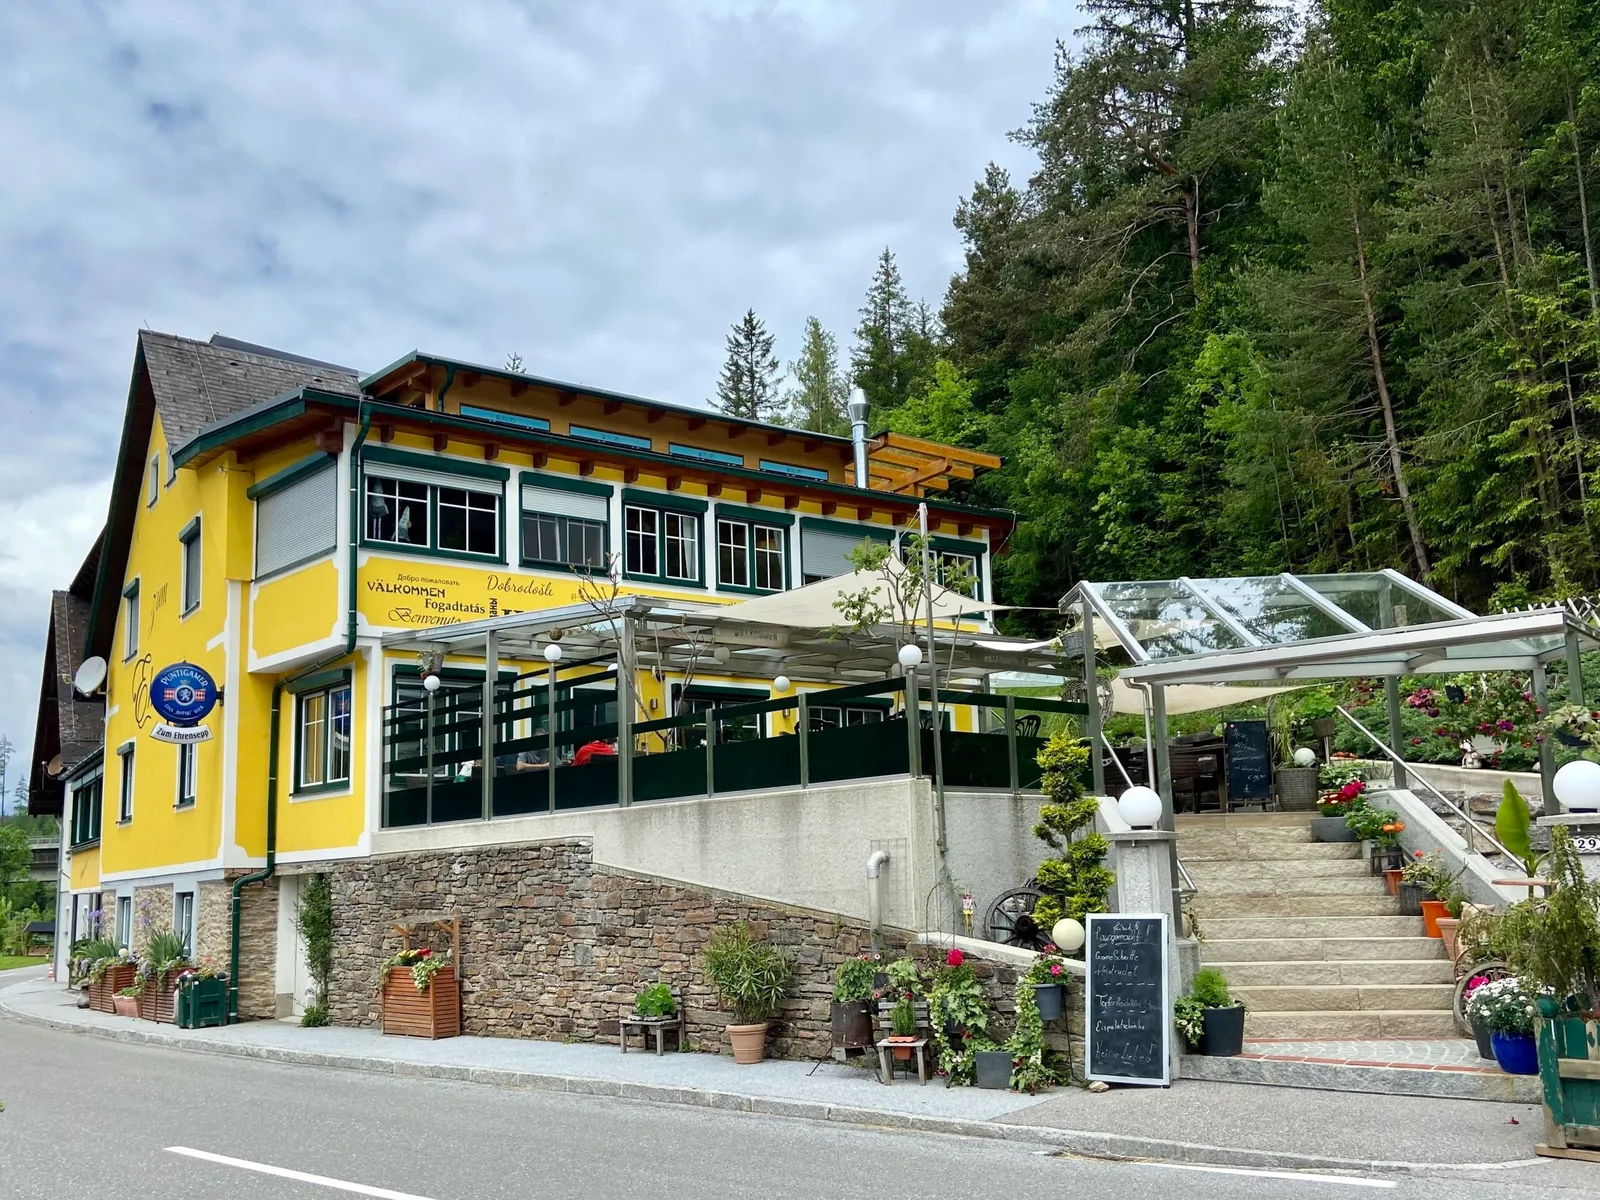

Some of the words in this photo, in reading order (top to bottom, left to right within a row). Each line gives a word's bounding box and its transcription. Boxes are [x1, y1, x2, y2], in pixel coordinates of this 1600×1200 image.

[397, 573, 420, 583] Добро
[421, 577, 460, 586] пожаловать
[367, 579, 446, 598] VÄLKOMMEN
[424, 598, 486, 614] Fogadtatás
[160, 669, 209, 688] PUNTIGAMER
[156, 726, 172, 738] Zum
[173, 729, 209, 740] Ehrensepp
[1577, 838, 1597, 849] 29
